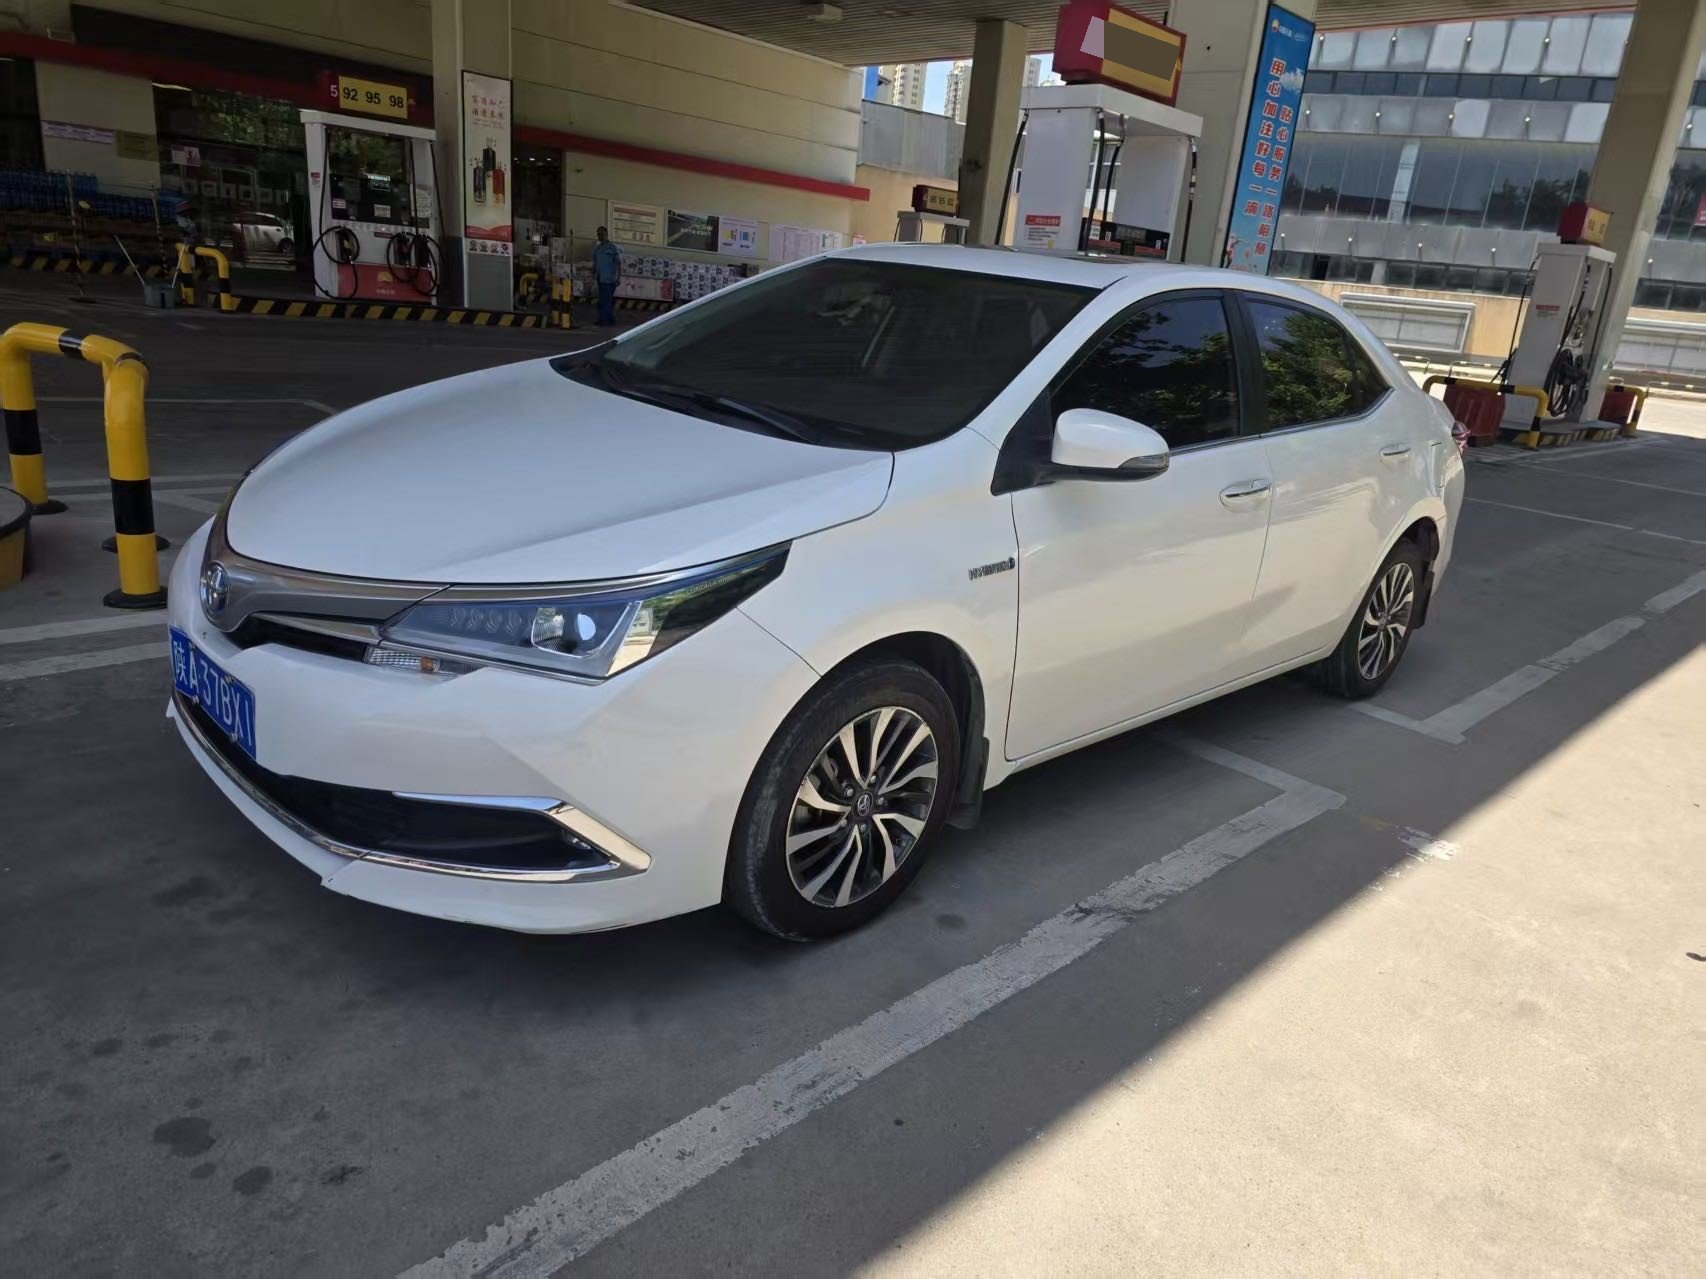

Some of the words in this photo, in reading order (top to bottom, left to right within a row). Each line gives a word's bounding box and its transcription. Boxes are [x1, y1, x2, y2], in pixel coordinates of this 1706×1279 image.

[330, 84, 339, 98] 5
[343, 87, 359, 101] 92
[365, 91, 381, 105] 95
[389, 95, 405, 109] 98
[1244, 57, 1287, 217] 用心加注好每一滴
